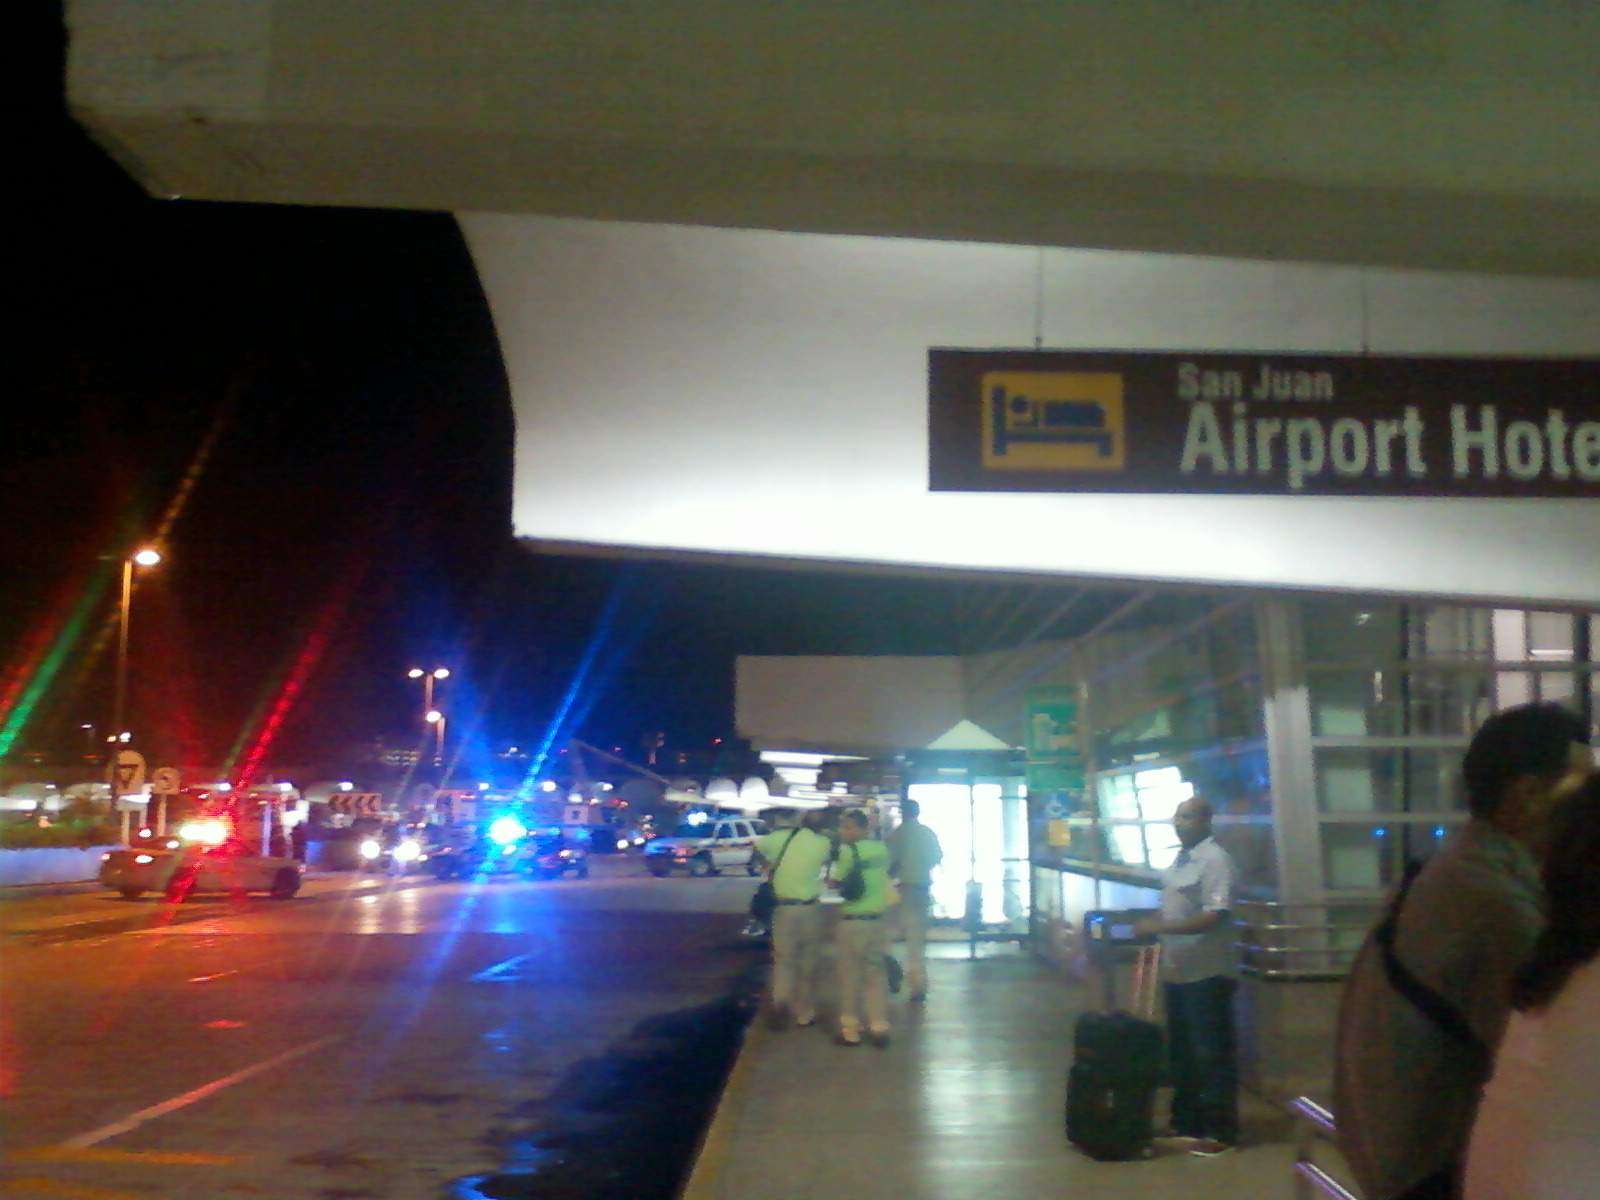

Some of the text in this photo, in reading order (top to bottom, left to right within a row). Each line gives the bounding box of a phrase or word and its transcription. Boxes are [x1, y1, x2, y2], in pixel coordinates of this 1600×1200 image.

[1178, 363, 1335, 400] San Juan
[1180, 403, 1426, 489] Airport
